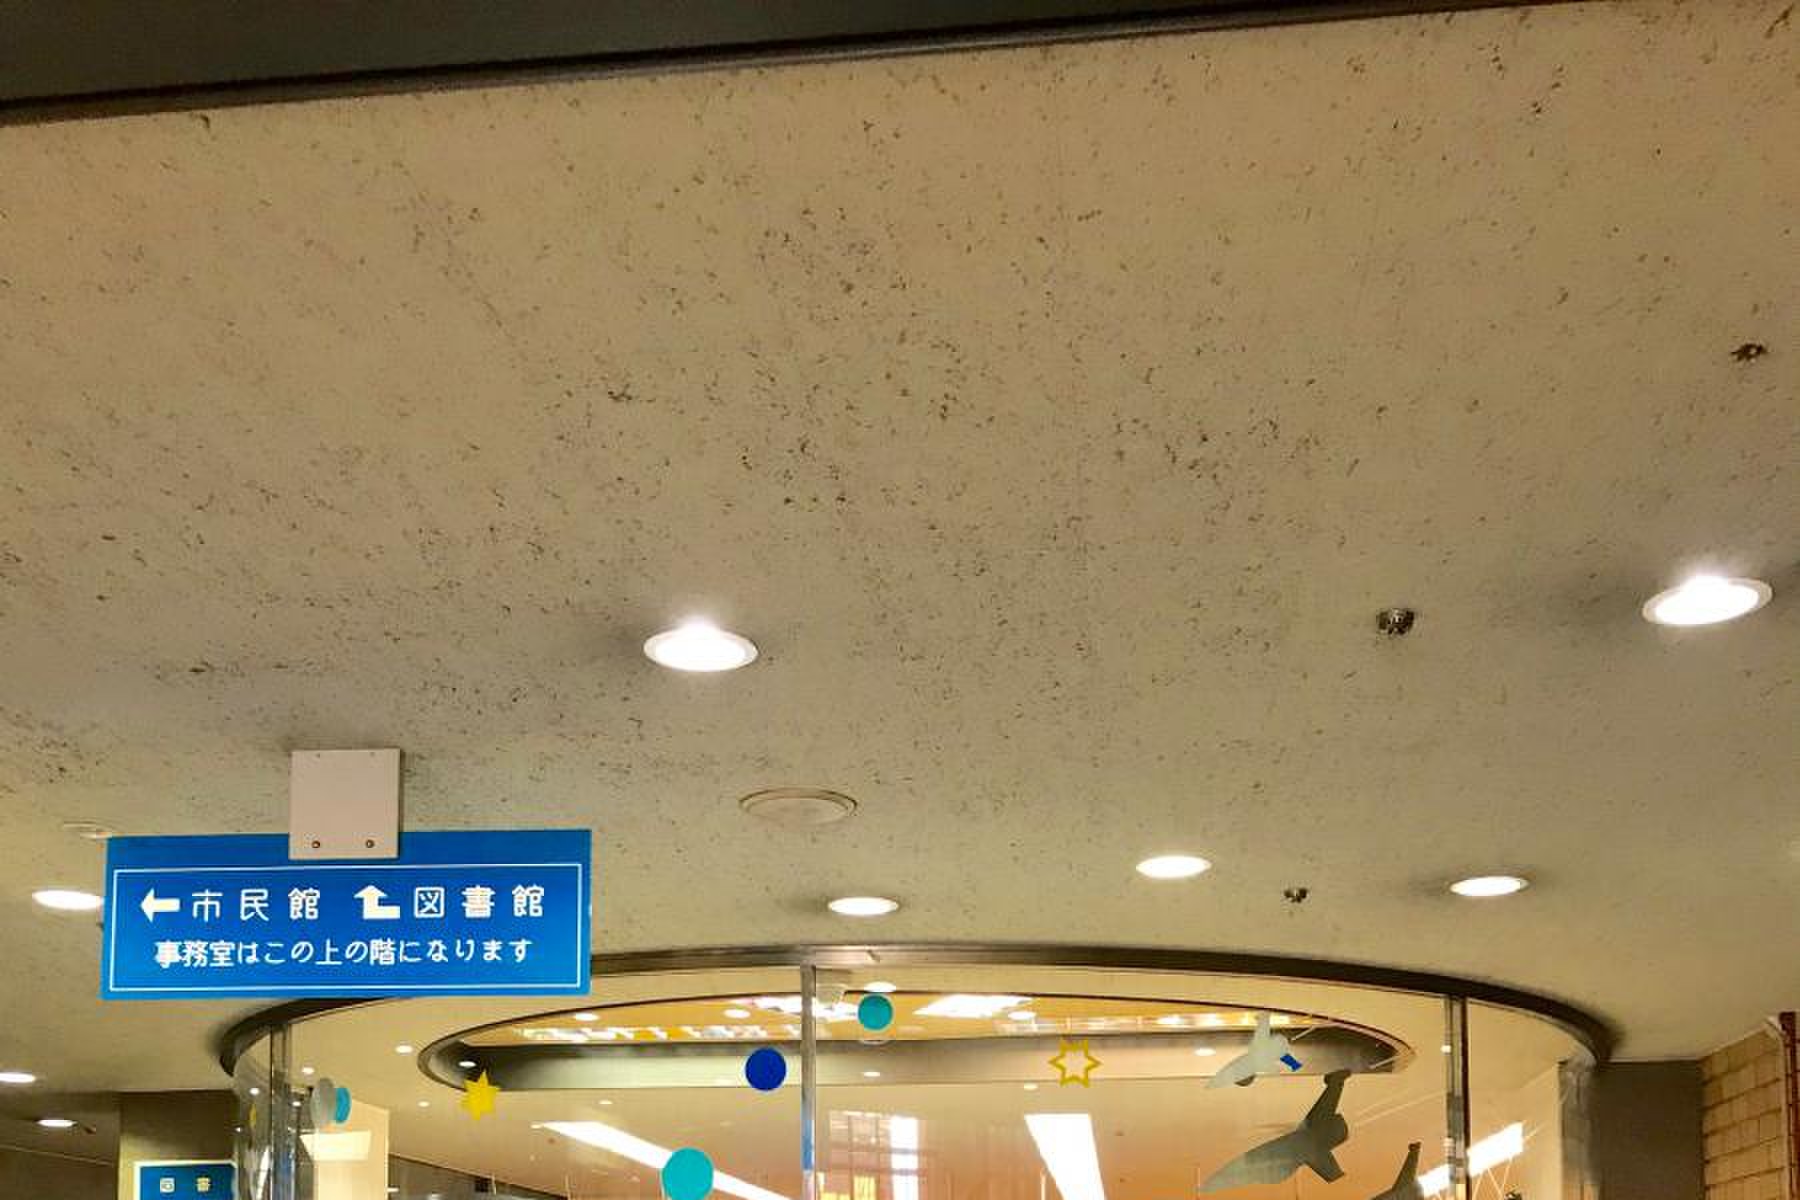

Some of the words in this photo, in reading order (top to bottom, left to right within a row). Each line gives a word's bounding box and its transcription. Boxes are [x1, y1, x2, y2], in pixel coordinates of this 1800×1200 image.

[191, 887, 321, 921] 市民館
[413, 884, 546, 919] 図書館
[154, 937, 534, 969] 事務室はこの上の階になります
